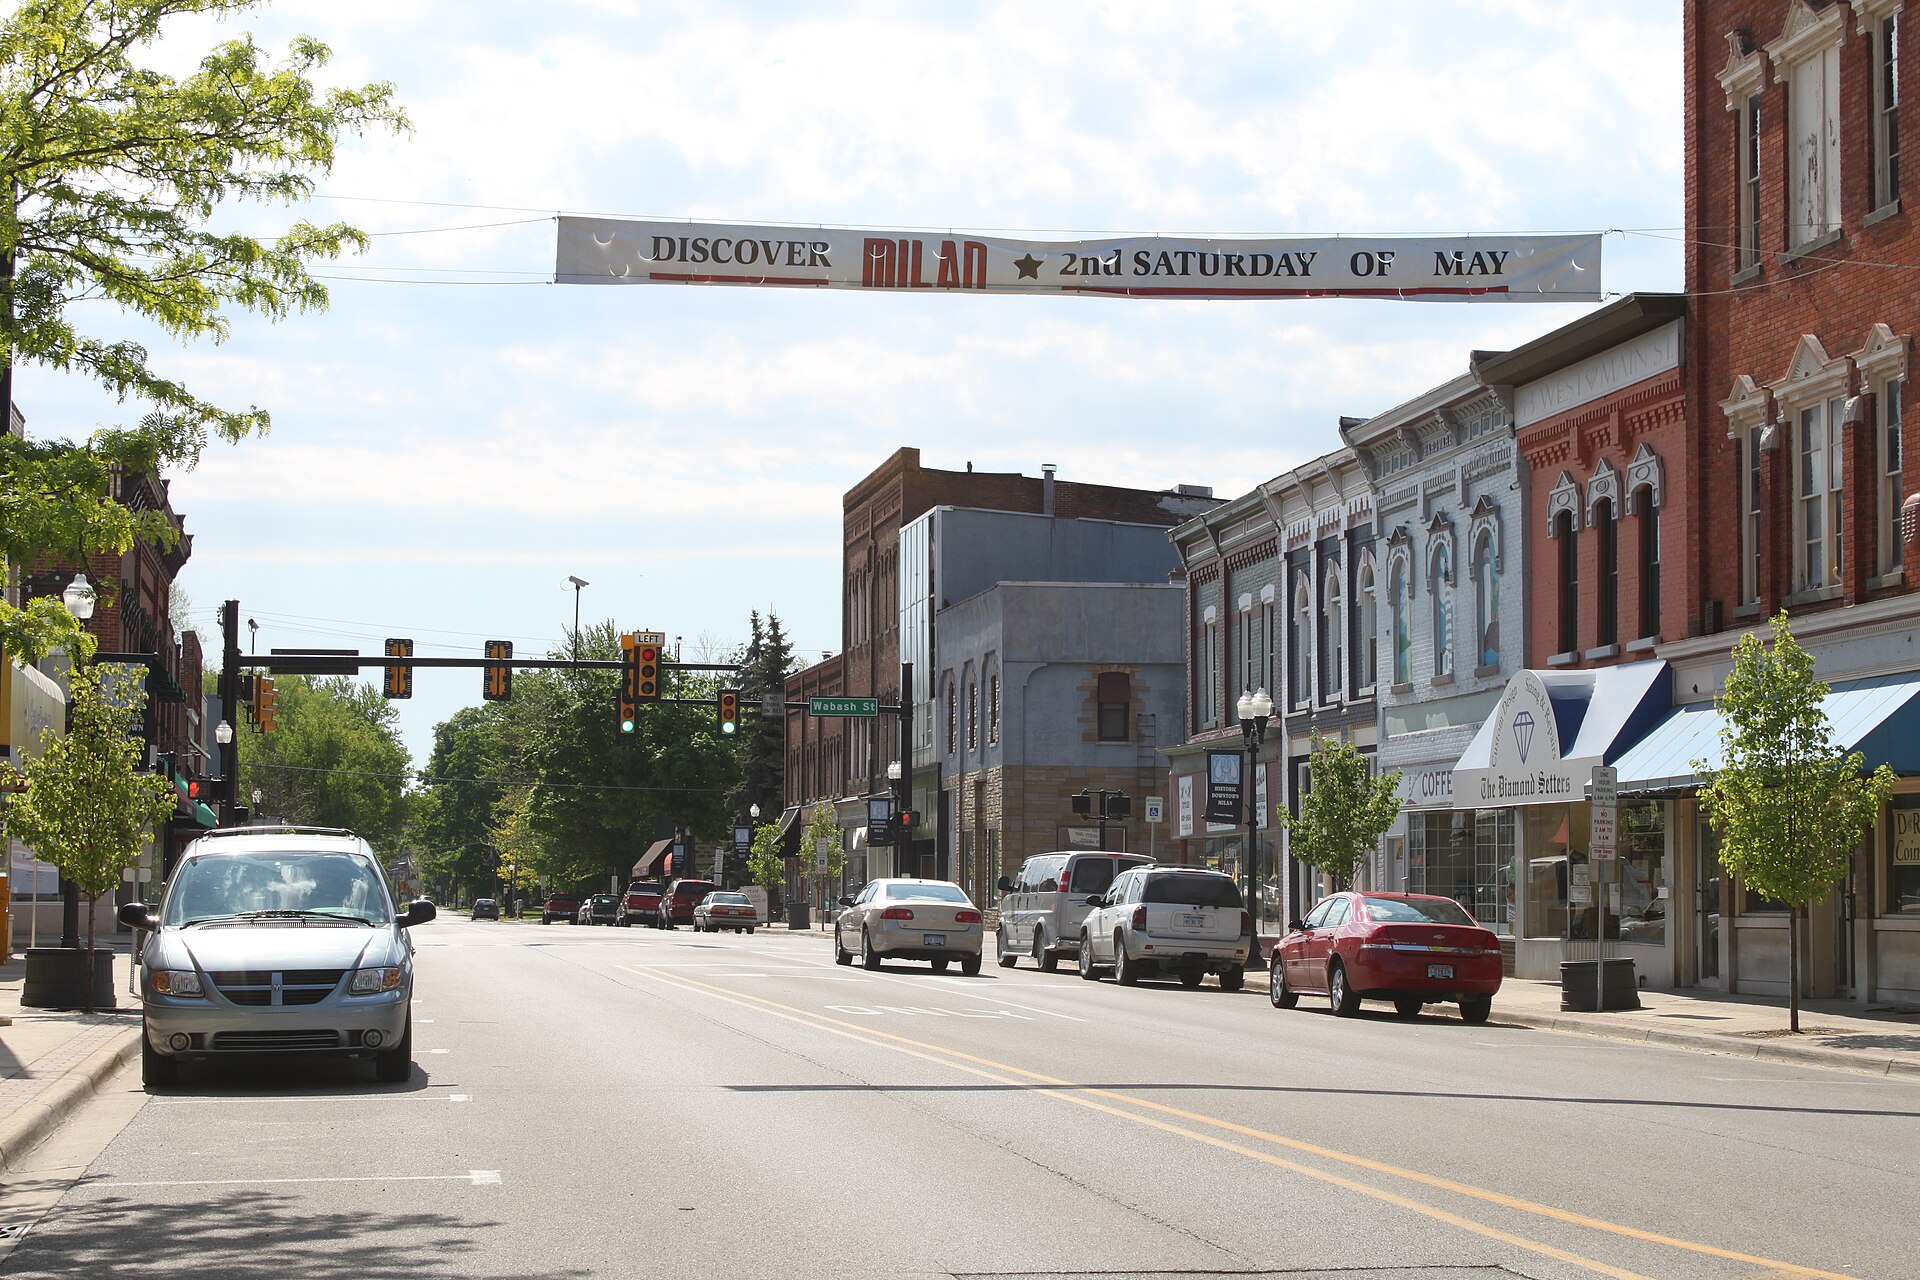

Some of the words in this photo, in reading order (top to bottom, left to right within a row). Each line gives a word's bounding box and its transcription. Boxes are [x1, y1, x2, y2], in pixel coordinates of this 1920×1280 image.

[650, 235, 832, 268] DISCOVER
[862, 238, 988, 289] MILAN
[1059, 249, 1123, 276] 2nd
[1132, 250, 1318, 277] SATURDAY
[1350, 251, 1396, 277] OF
[1434, 250, 1510, 276] MAY
[1537, 369, 1583, 410] WEST
[1600, 346, 1649, 388] MAIN
[638, 634, 660, 643] LEFT
[813, 701, 857, 711] Wabash
[862, 702, 875, 711] St
[1491, 716, 1505, 767] Custom
[1502, 686, 1518, 716] Design
[1525, 677, 1541, 706] Sizing
[1544, 707, 1558, 760] Repairs
[1480, 777, 1496, 800] The
[1498, 772, 1535, 798] Diamond
[1538, 770, 1571, 795] Setters
